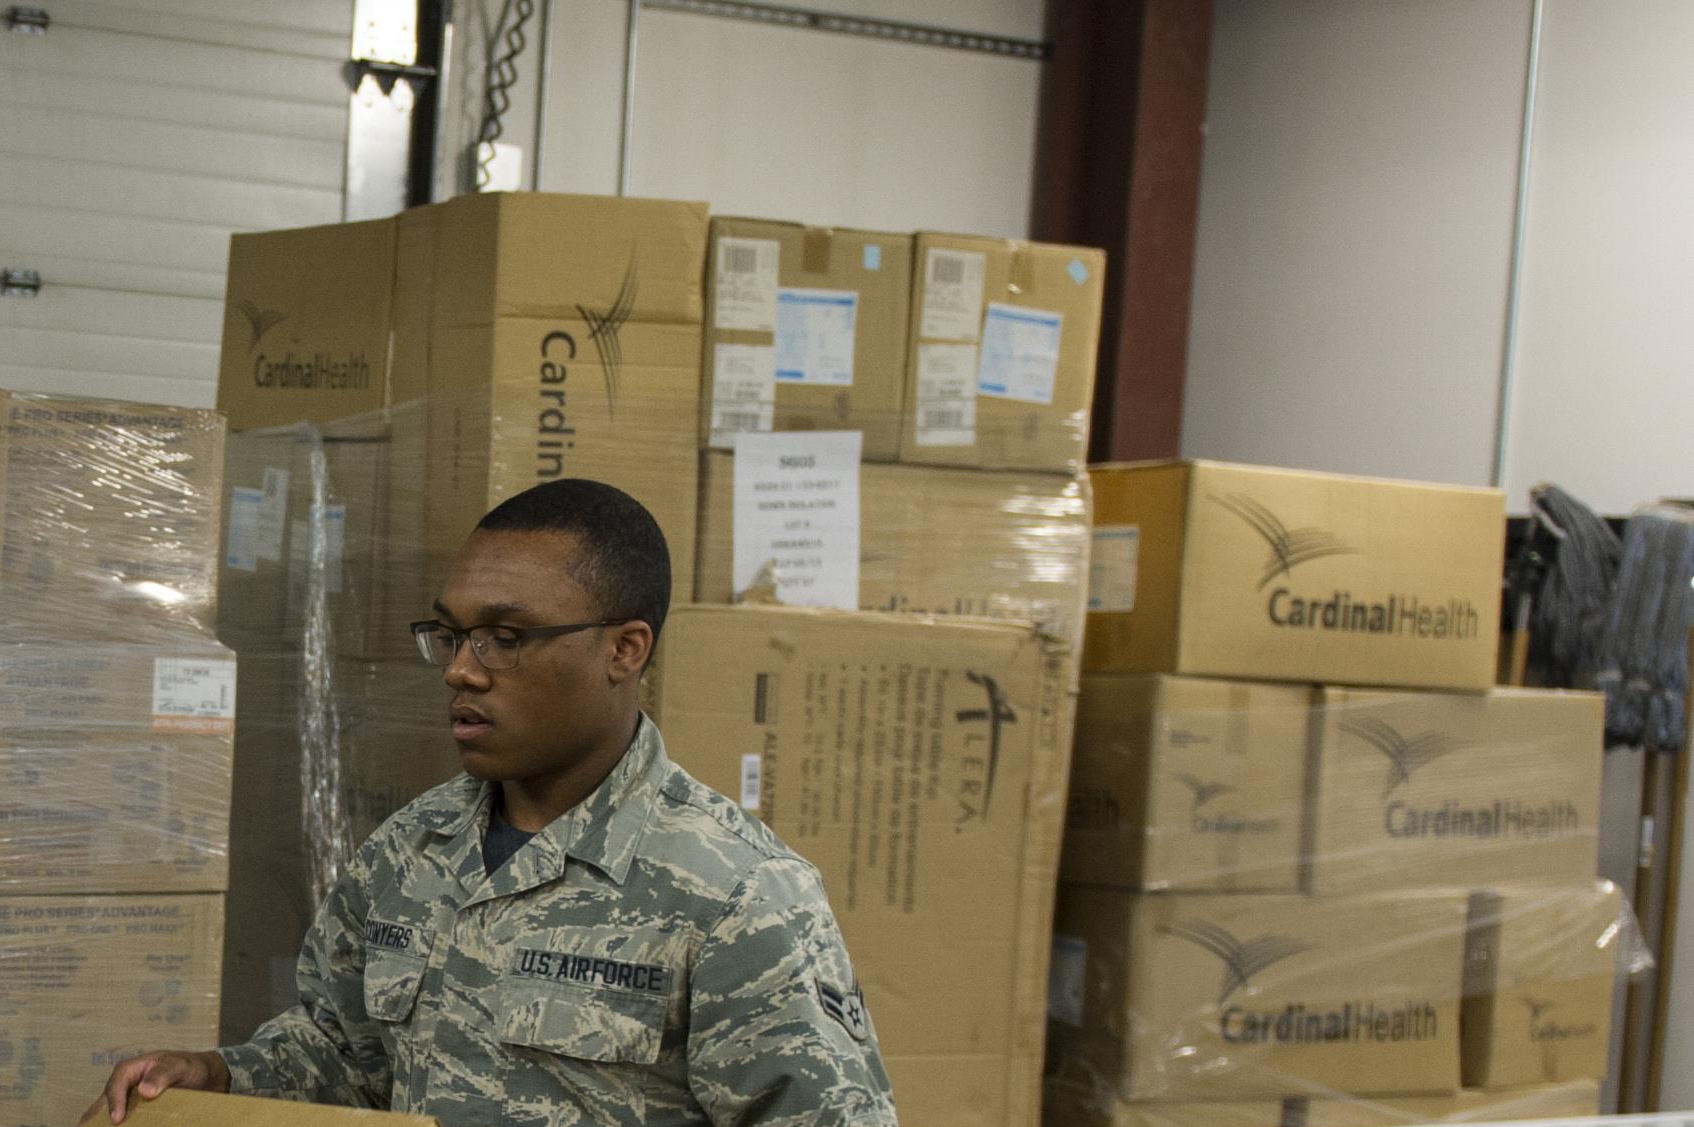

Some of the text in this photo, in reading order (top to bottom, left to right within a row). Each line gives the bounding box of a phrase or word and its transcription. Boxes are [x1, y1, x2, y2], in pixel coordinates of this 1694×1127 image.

[1269, 588, 1479, 640] CardinalHealth
[1385, 800, 1579, 838] CardinalHealth
[1221, 1002, 1438, 1044] CardinalHealth
